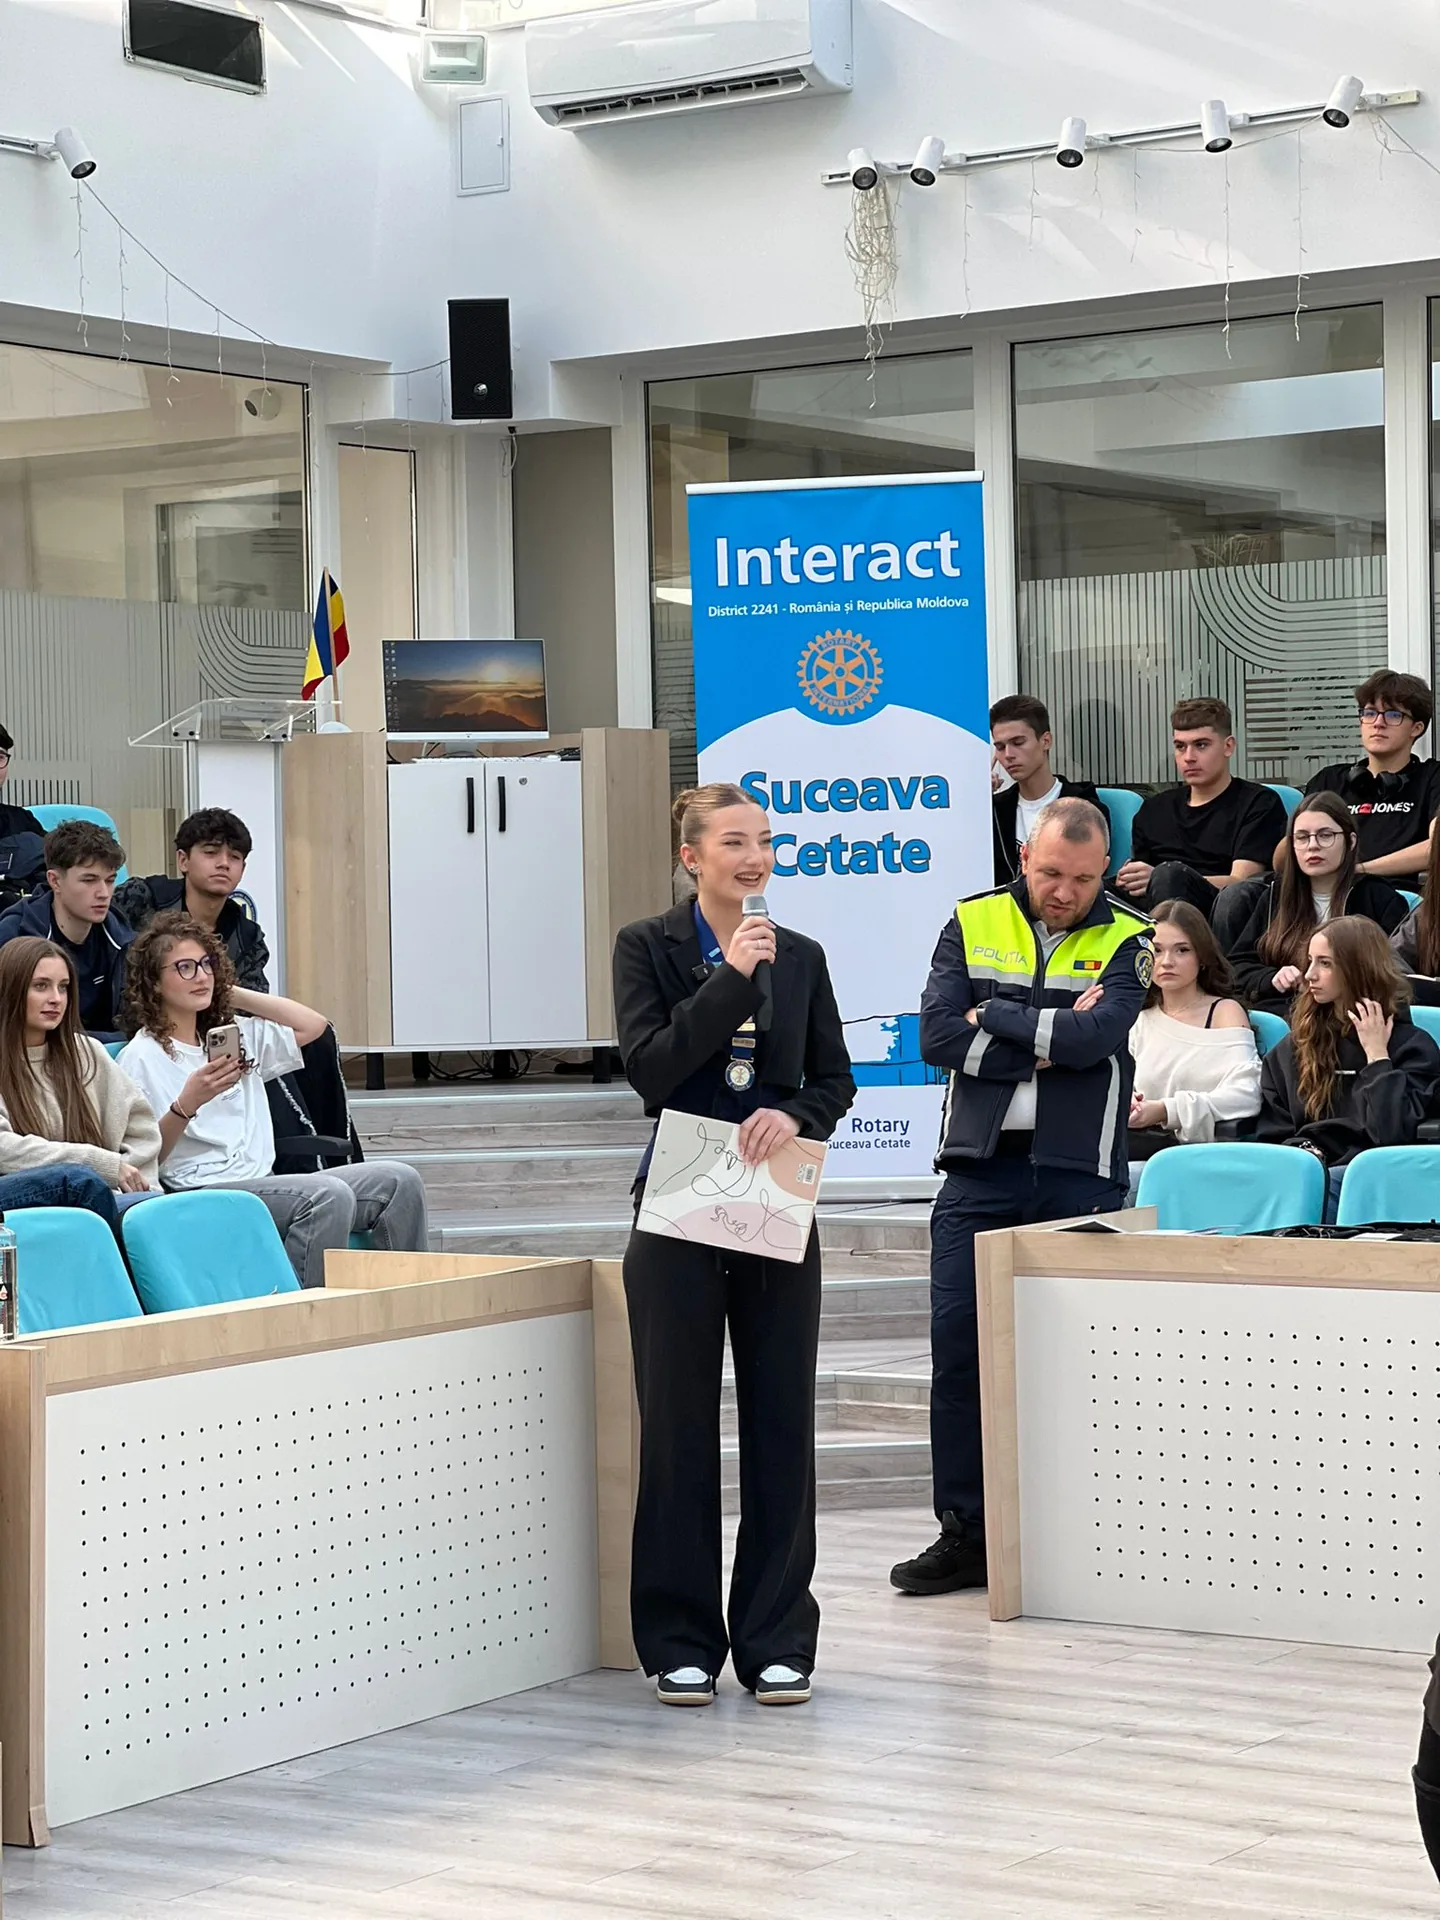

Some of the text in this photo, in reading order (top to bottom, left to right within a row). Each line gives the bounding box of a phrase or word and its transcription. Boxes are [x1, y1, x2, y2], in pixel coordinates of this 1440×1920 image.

[715, 530, 961, 587] Interact
[708, 605, 748, 617] District
[751, 603, 779, 615] 2241
[789, 601, 841, 613] România
[844, 600, 854, 614] și
[856, 598, 913, 613] Republica
[916, 596, 969, 608] Moldova
[821, 638, 857, 649] ROTARY
[739, 770, 950, 815] Suceava
[772, 831, 931, 877] Cetate
[852, 1117, 910, 1135] Rotary
[874, 1138, 911, 1149] Cetate
